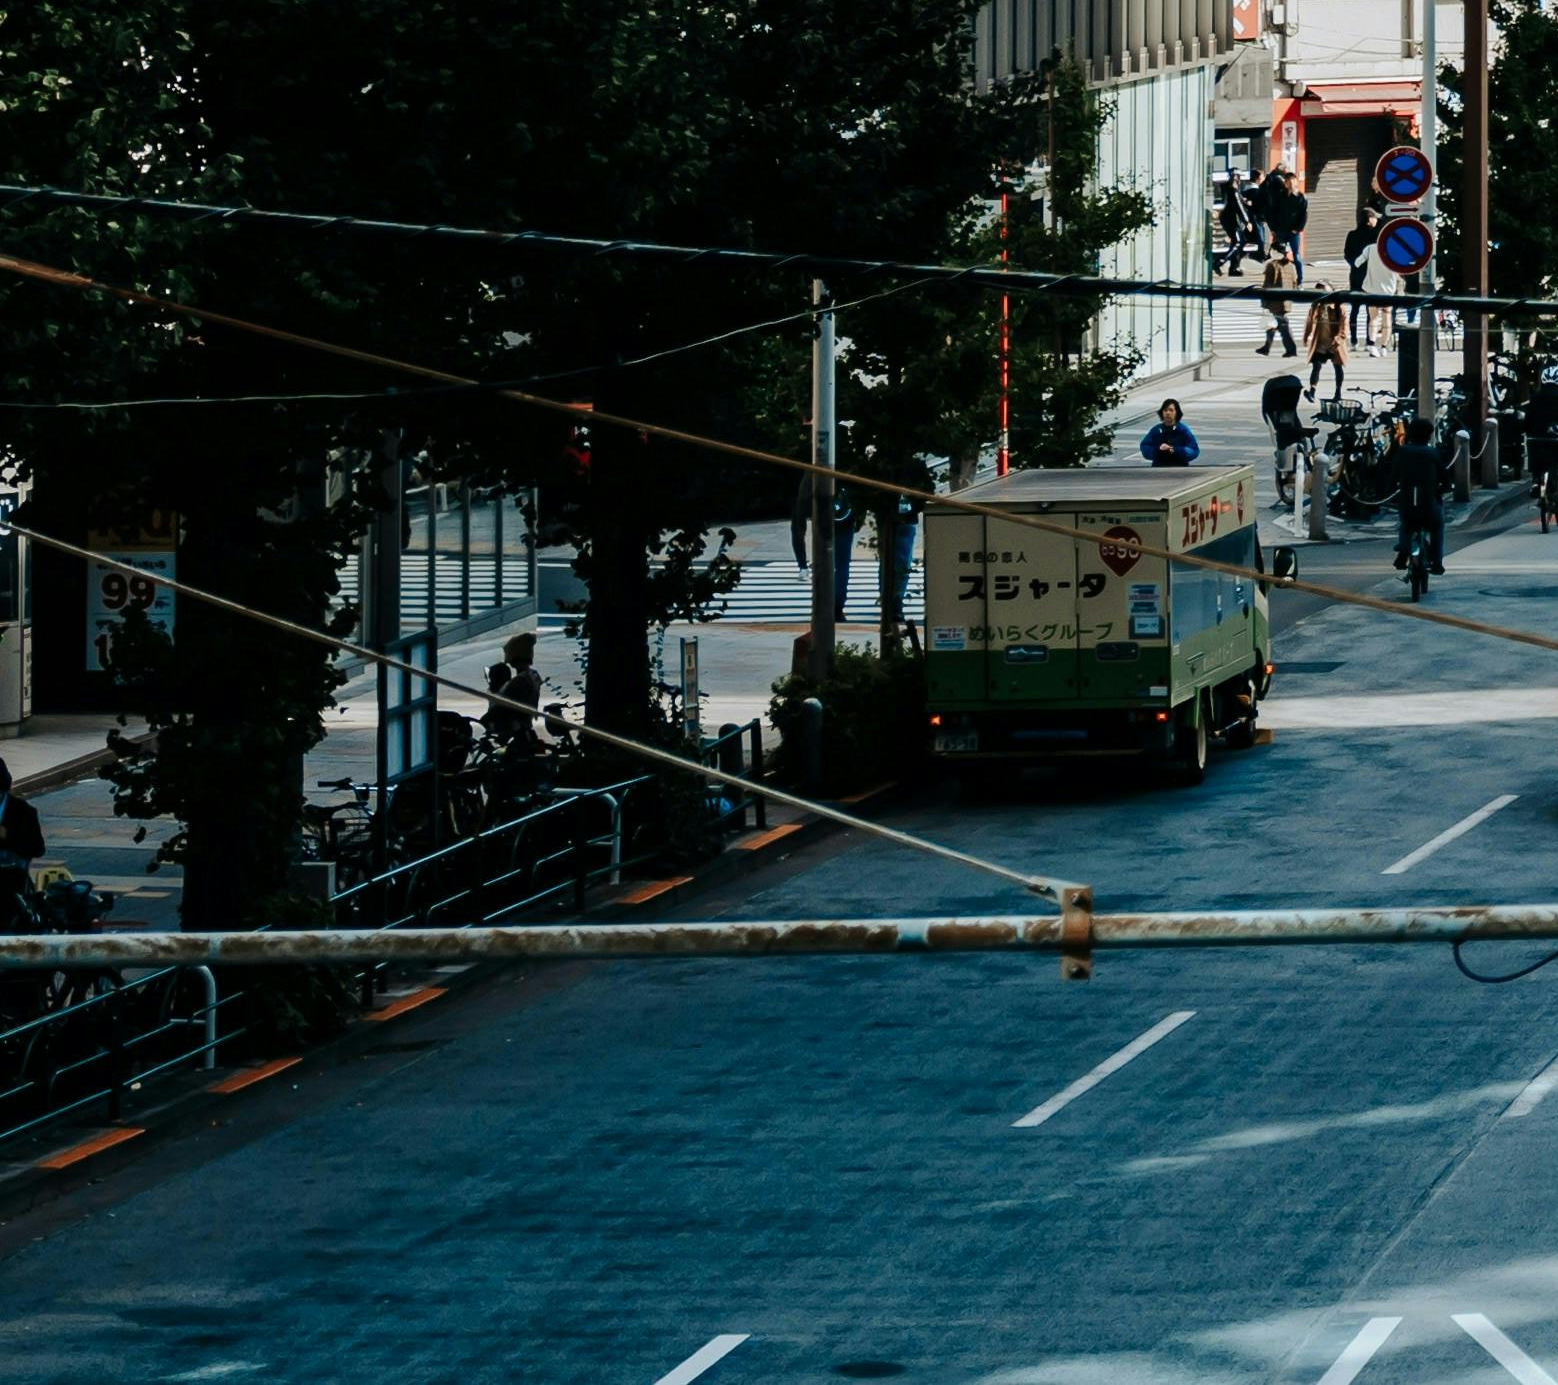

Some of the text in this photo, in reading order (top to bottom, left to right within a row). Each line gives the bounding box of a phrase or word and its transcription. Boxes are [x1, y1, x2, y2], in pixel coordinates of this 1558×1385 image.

[958, 573, 1107, 601] スジャータ
[968, 622, 1113, 642] めいらくグループ
